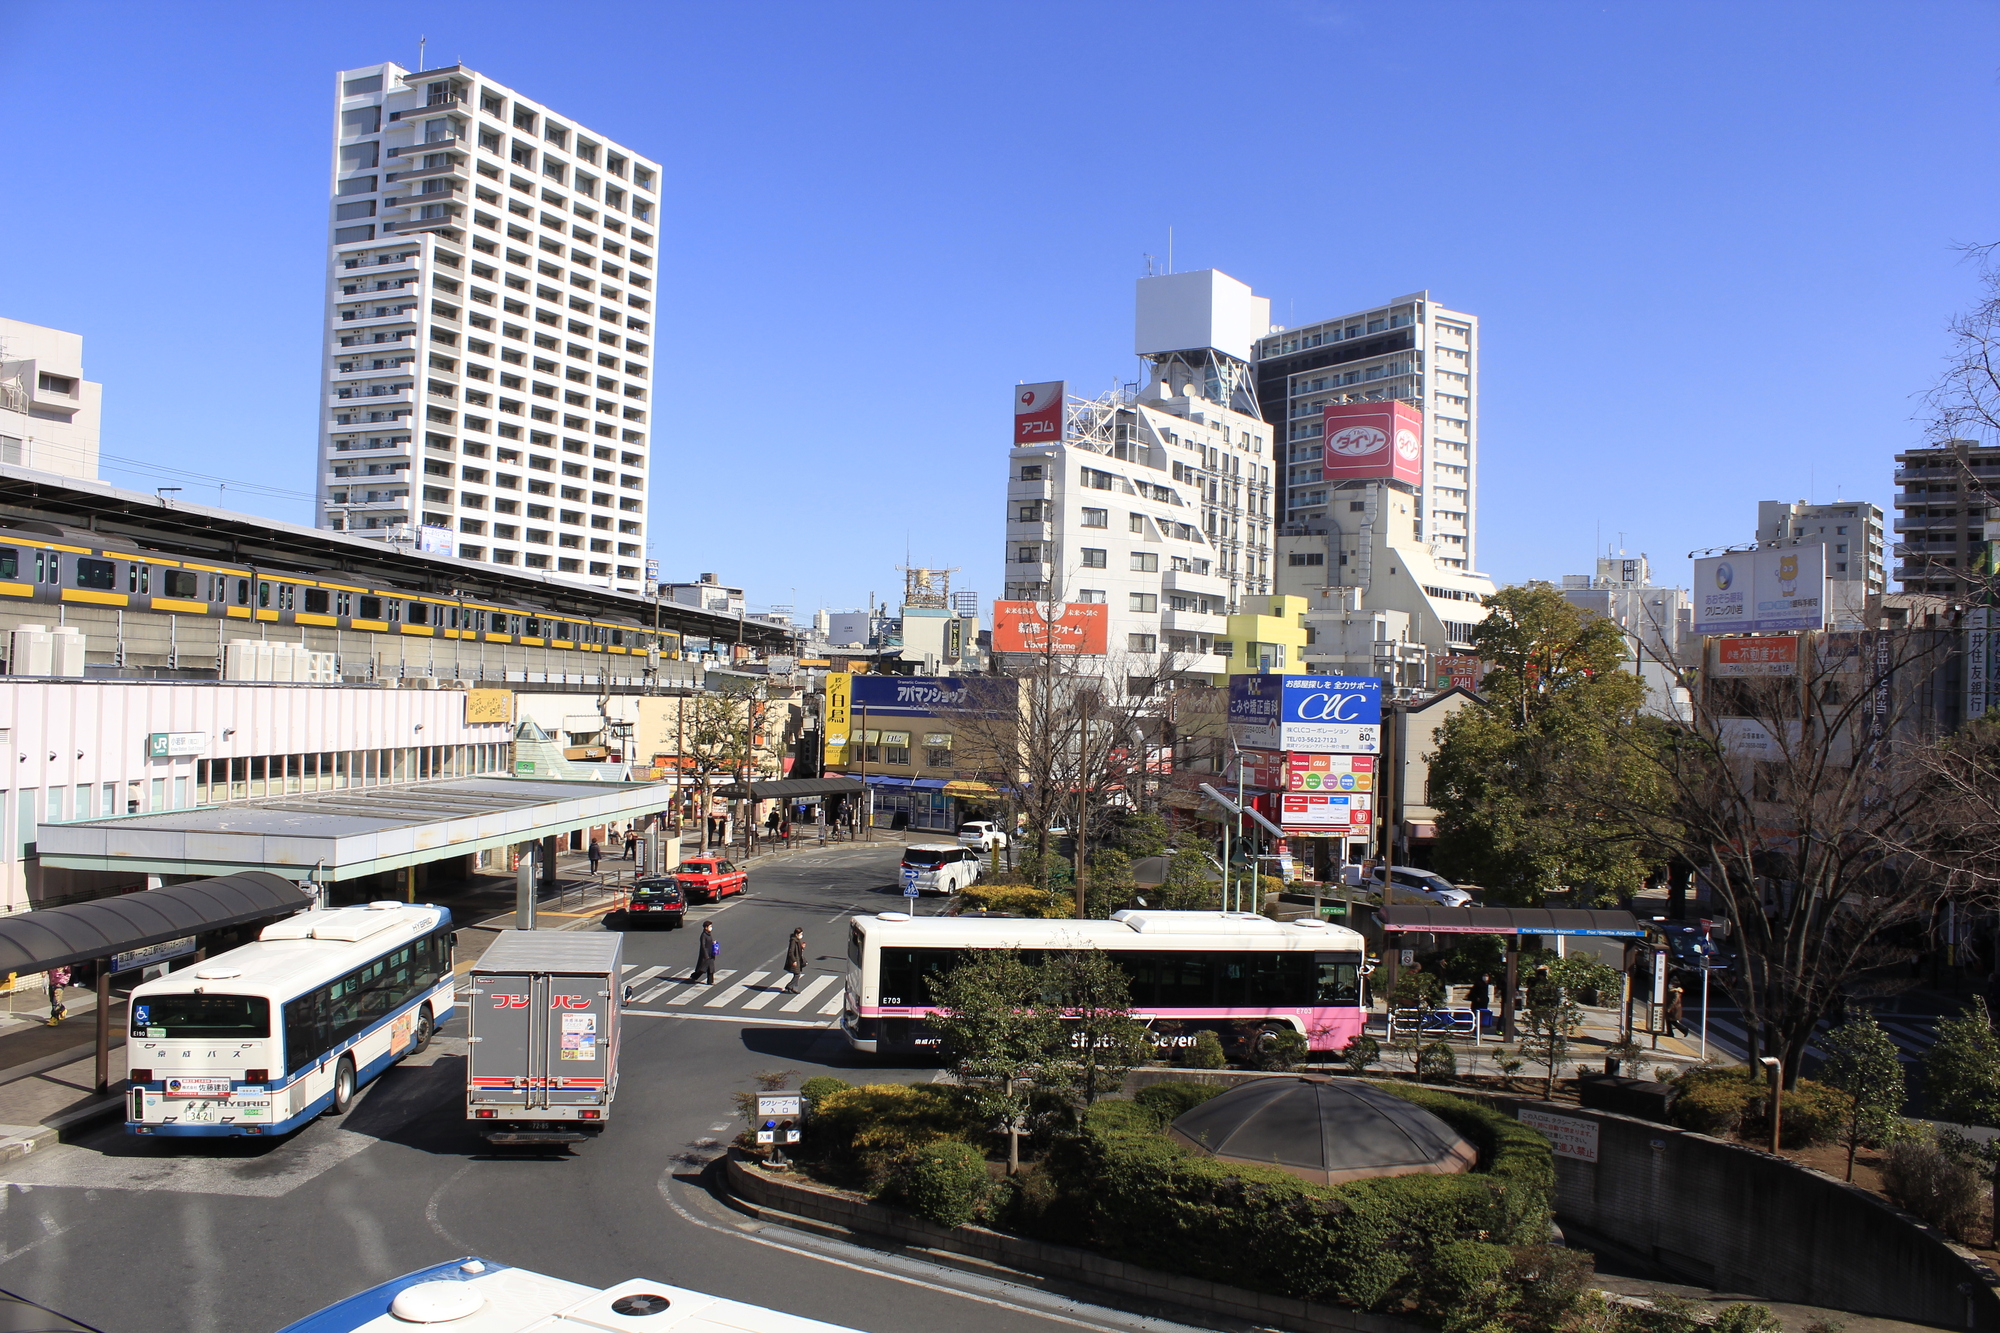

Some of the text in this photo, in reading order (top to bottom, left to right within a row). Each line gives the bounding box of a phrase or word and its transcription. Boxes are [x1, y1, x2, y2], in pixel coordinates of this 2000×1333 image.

[1022, 420, 1054, 434] アコム
[1336, 435, 1384, 450] ダイソー
[1398, 438, 1417, 453] ダイソー
[1705, 592, 1743, 604] あおぞら眼科
[1705, 604, 1743, 616] クリニック小岩
[1052, 641, 1075, 650] Home
[1740, 645, 1788, 660] 不動産ナビ
[1970, 616, 1982, 712] 三井住友銀行
[1285, 680, 1379, 690] お部屋探しを 全力サポート
[1438, 677, 1471, 688] 2F 24H
[897, 686, 968, 703] アパマンショップ
[831, 693, 845, 723] 白鳥
[1230, 699, 1278, 716] こみや矯正歯科
[154, 737, 167, 749] JR
[171, 737, 186, 745] 小岩駅
[412, 917, 433, 931] HYBRID
[491, 994, 591, 1010] フジパン
[1152, 1032, 1197, 1047] Seven
[157, 1050, 241, 1058] 京成バス
[199, 1083, 229, 1092] 佐藤建設
[1522, 1112, 1597, 1132] この入口は、タクシープールです。
